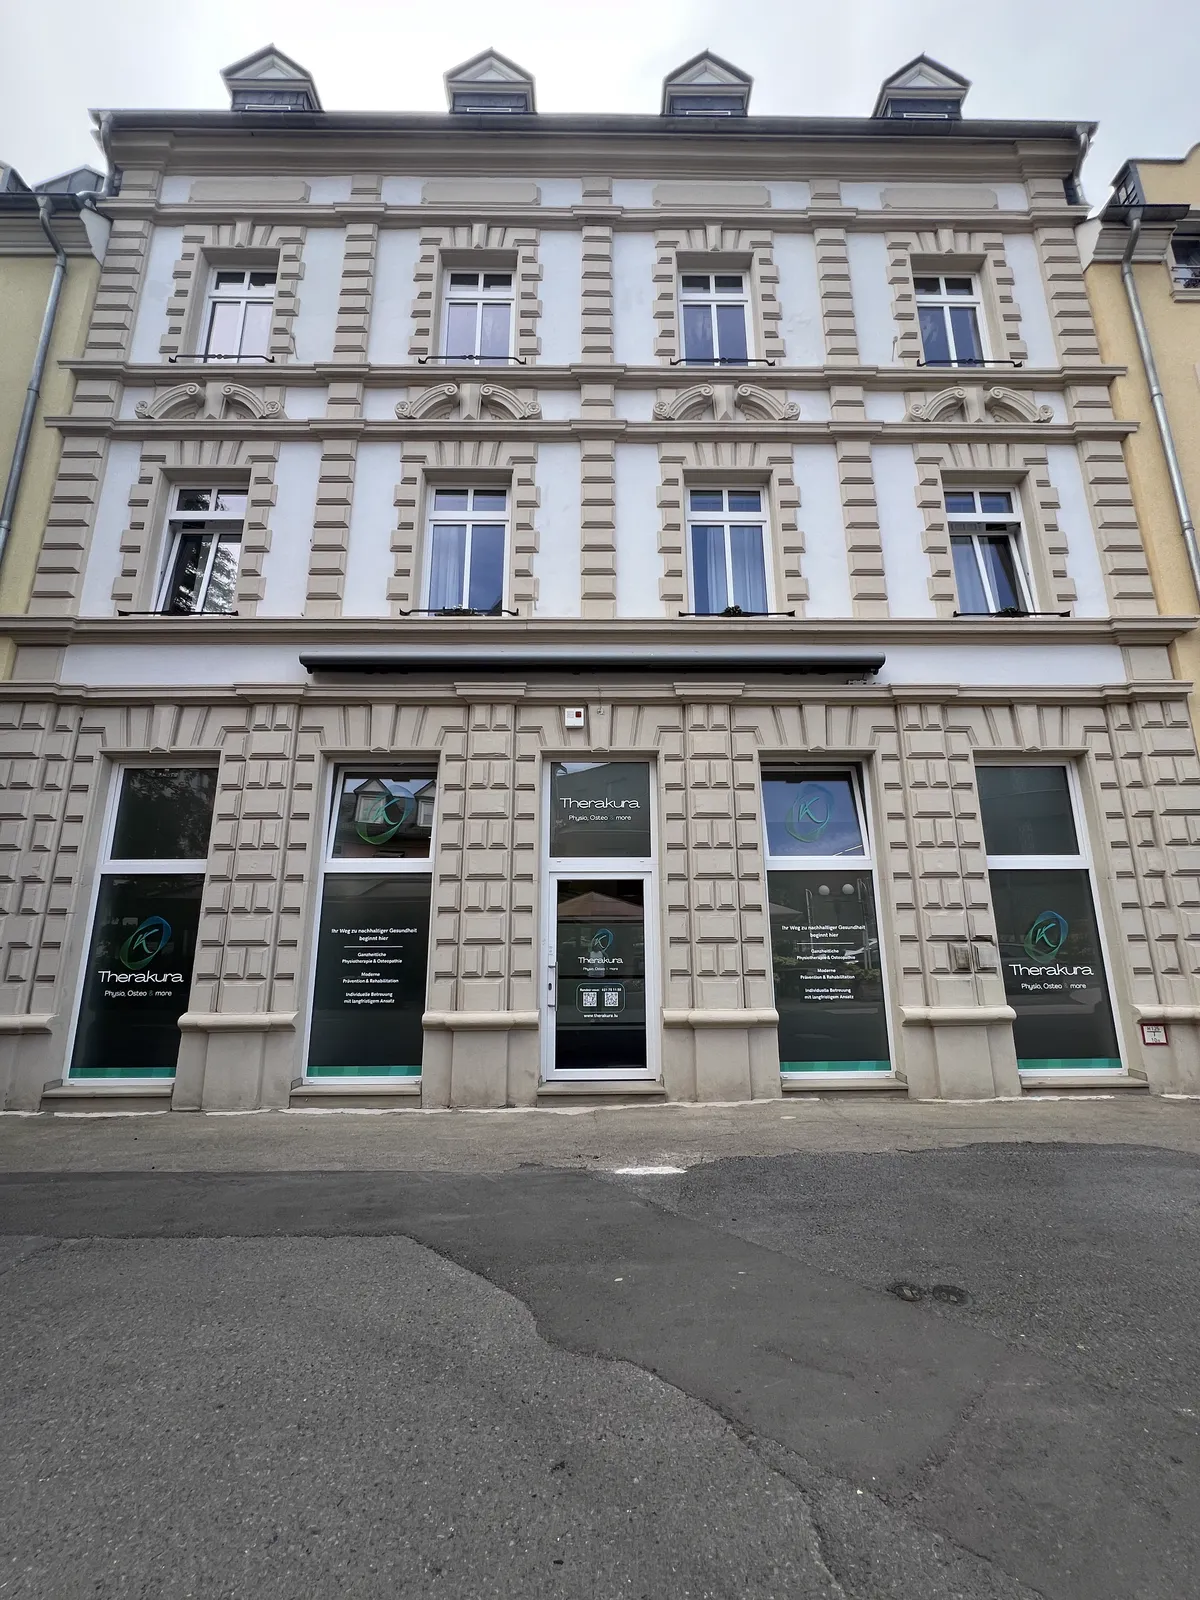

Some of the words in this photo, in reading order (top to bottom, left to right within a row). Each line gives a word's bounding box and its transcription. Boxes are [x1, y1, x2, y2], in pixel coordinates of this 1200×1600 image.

[559, 797, 641, 809] Therakura
[98, 970, 184, 982] Therakura
[1008, 964, 1094, 976] Therakura
[1021, 983, 1043, 991] Physio,
[104, 990, 126, 998] Physio,
